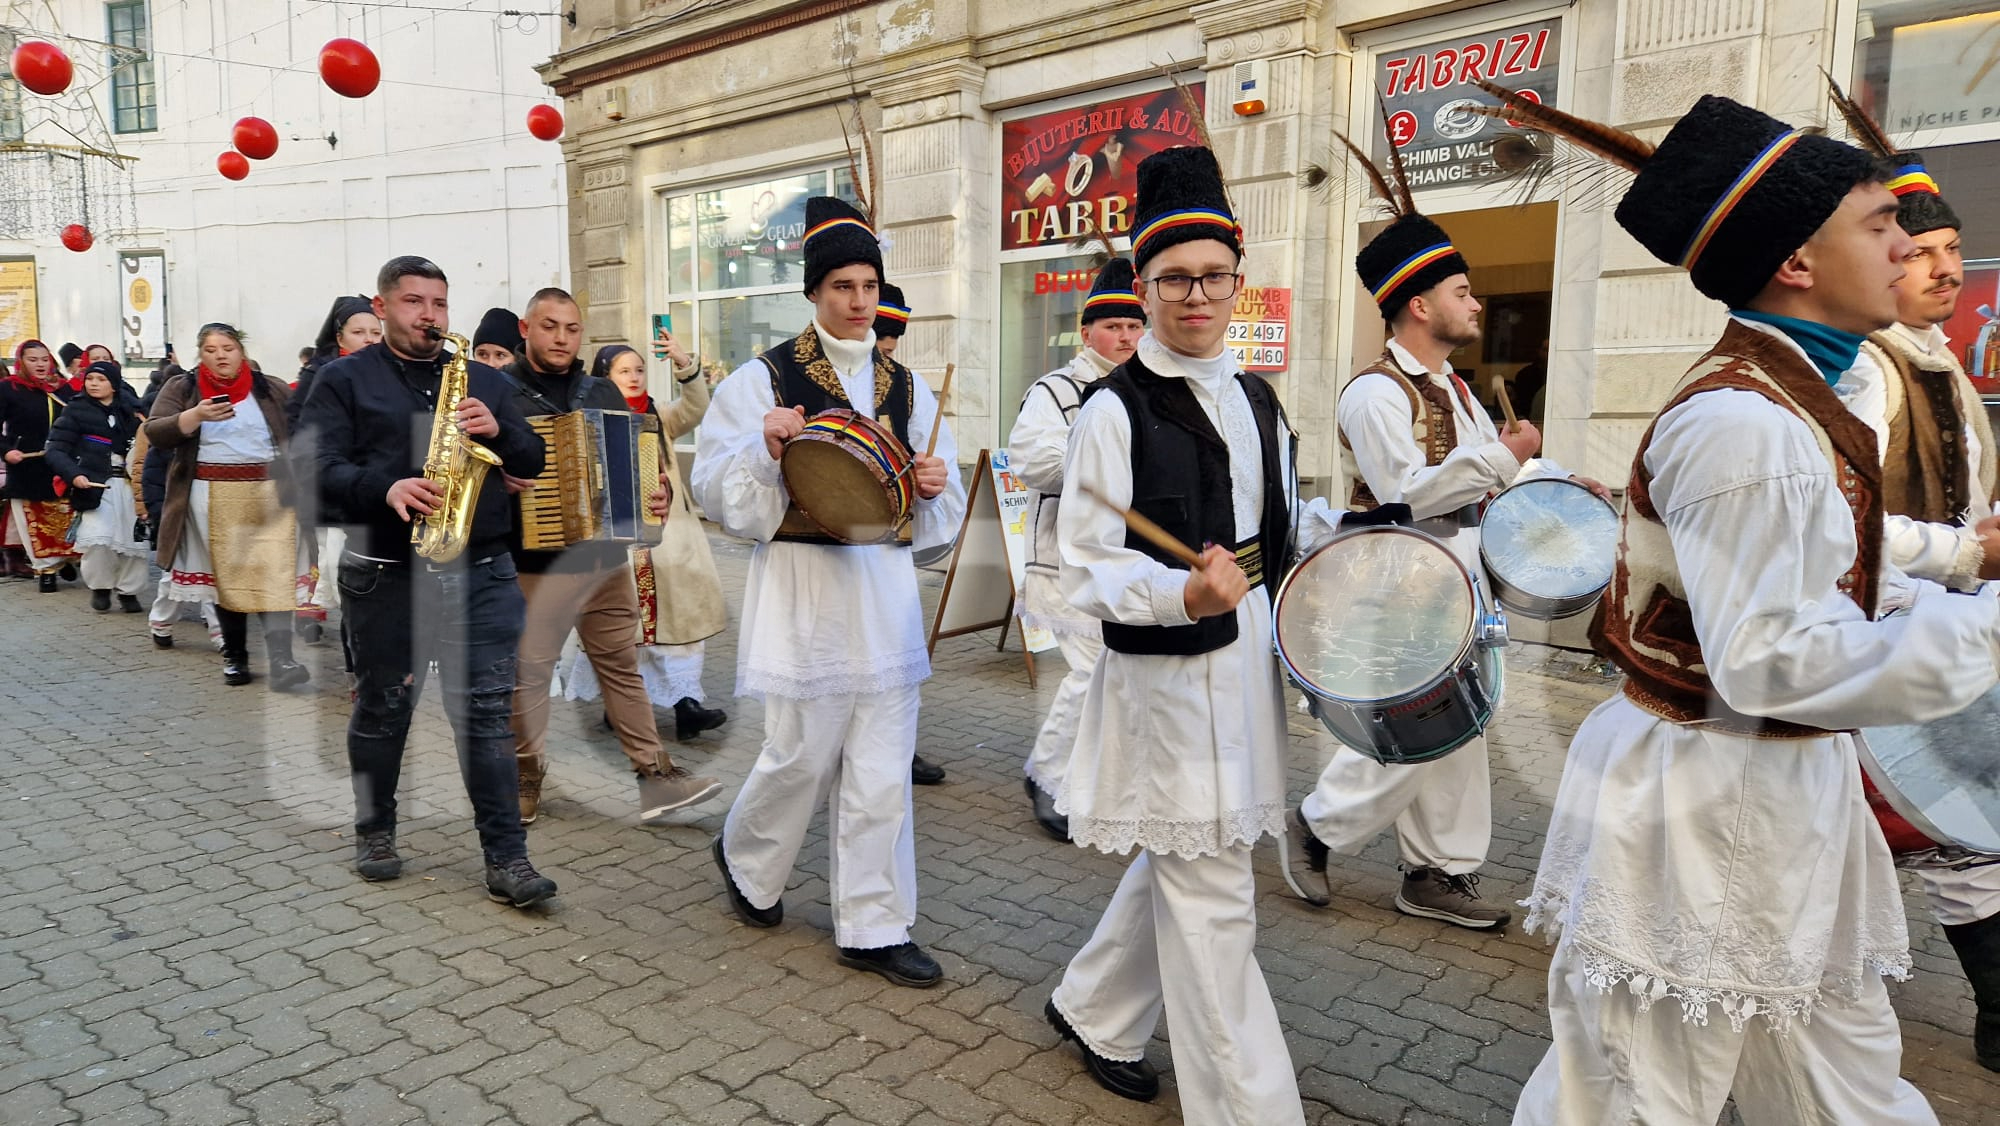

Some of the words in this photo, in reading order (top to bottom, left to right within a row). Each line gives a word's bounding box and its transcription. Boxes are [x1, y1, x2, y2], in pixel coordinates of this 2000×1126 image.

[1386, 29, 1550, 97] TABRIZI
[1901, 109, 1969, 128] NICHE
[1008, 107, 1124, 178] BIJUTERII
[1129, 107, 1149, 129] &
[1386, 146, 1450, 169] SCHIMB
[767, 221, 806, 241] GELAT
[1011, 193, 1137, 244] TABR
